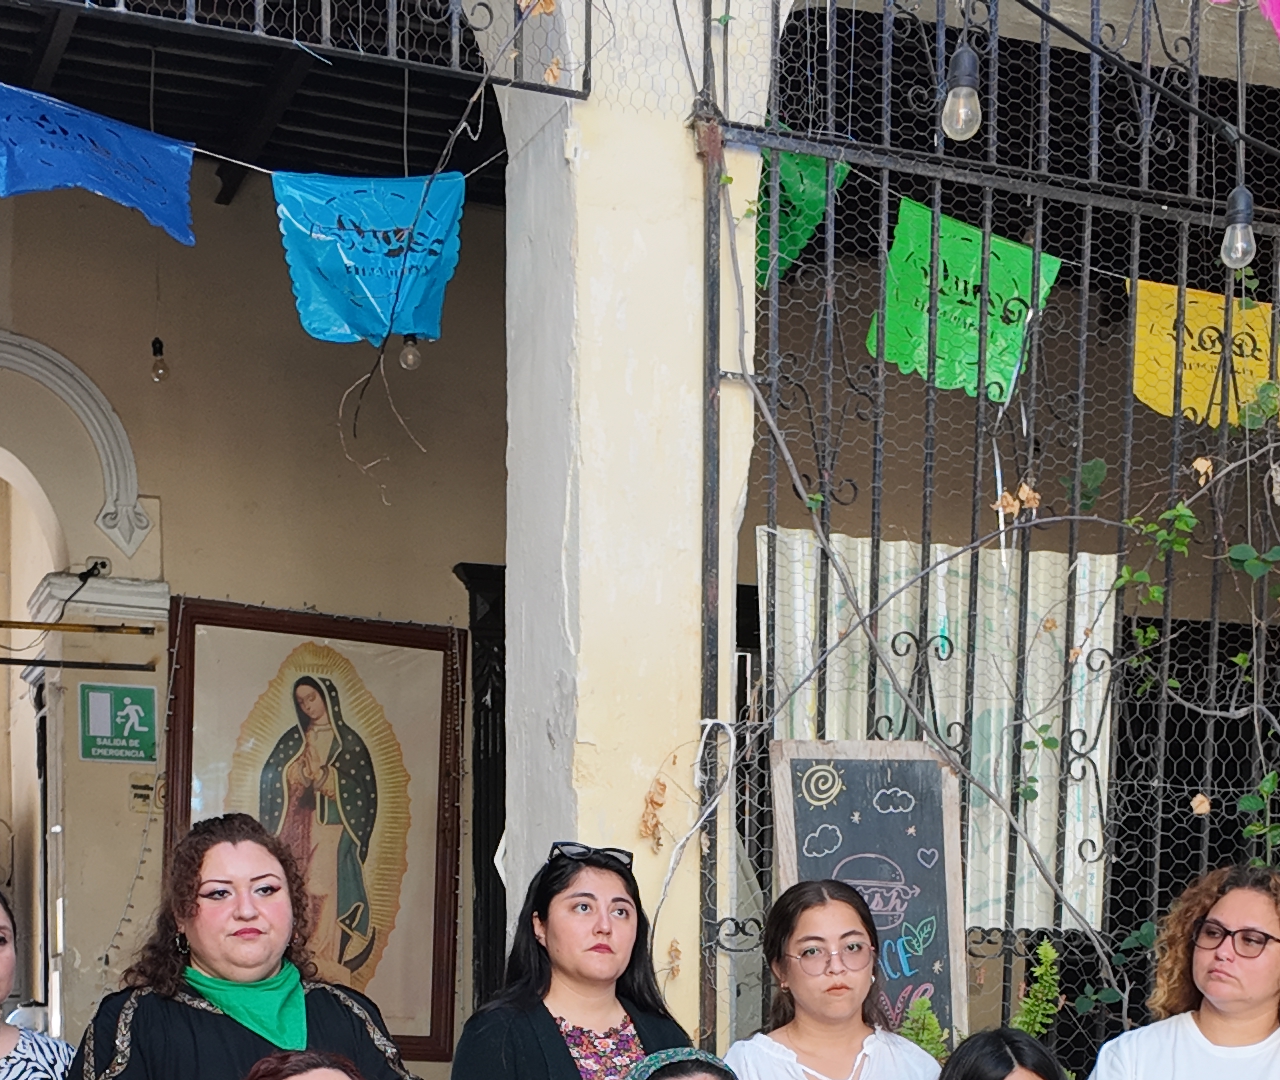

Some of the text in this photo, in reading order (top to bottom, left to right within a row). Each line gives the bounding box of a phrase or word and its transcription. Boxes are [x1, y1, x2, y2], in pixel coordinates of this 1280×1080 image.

[96, 737, 140, 748] SALIDA DE
[91, 747, 145, 758] EMERGENCIA
